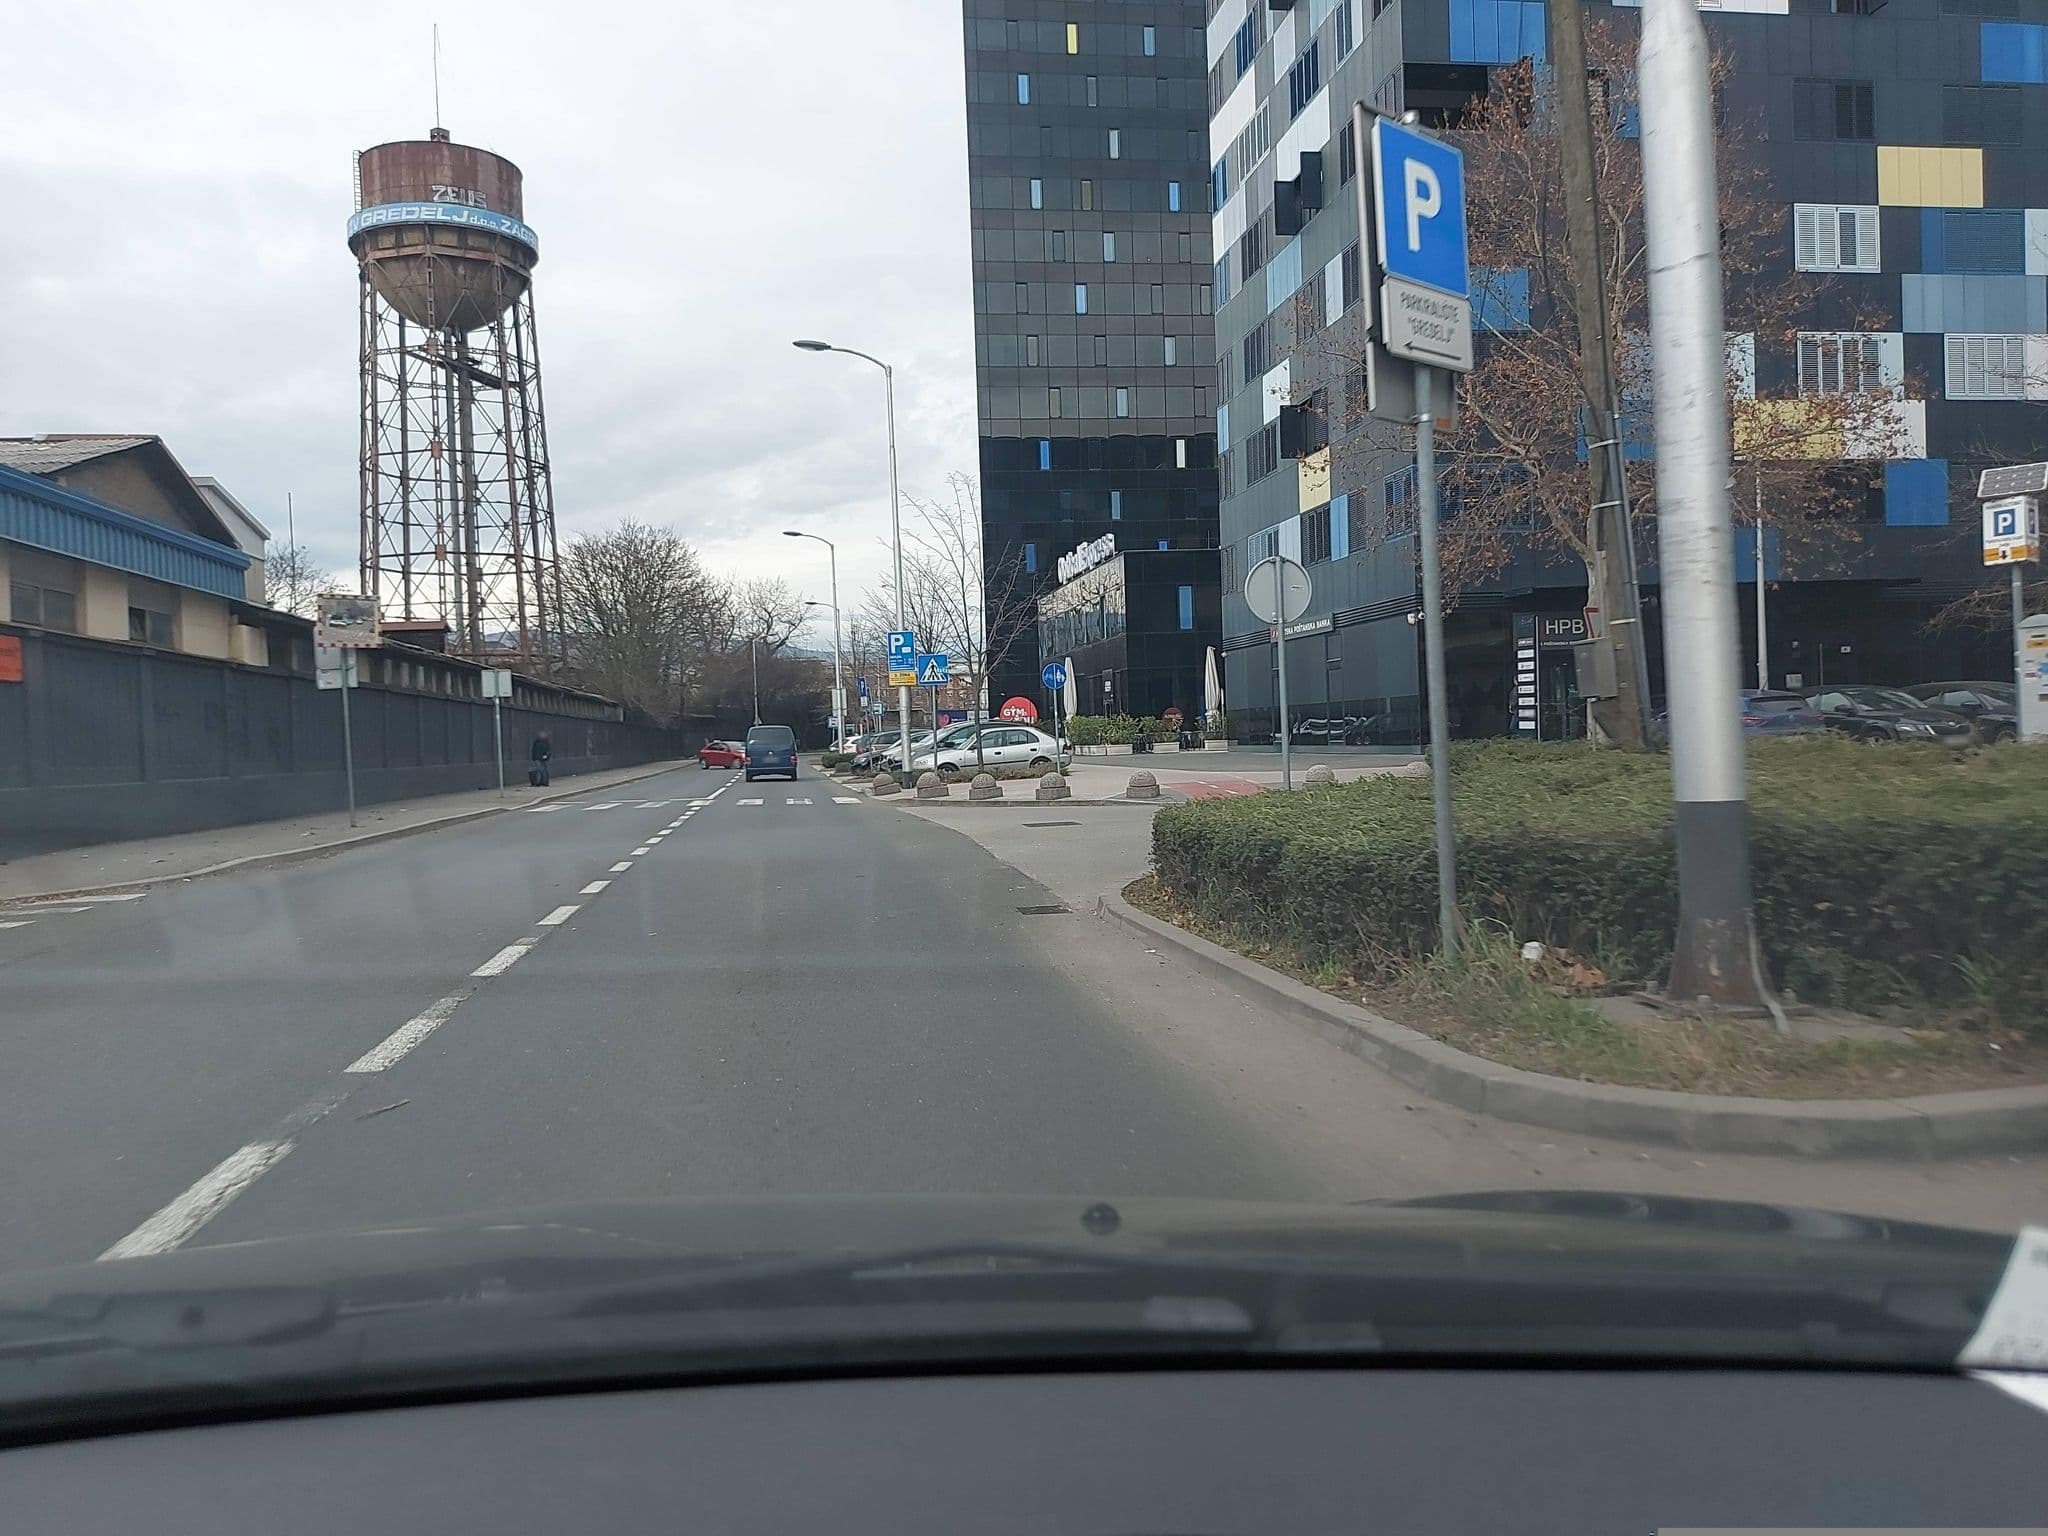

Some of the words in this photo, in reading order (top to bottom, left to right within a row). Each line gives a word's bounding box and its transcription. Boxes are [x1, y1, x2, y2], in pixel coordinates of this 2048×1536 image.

[431, 185, 487, 209] ZEUS
[1404, 157, 1441, 252] P
[361, 206, 468, 226] GREDELJ
[1998, 513, 2012, 534] P
[1545, 619, 1585, 635] HPB
[890, 634, 904, 654] P
